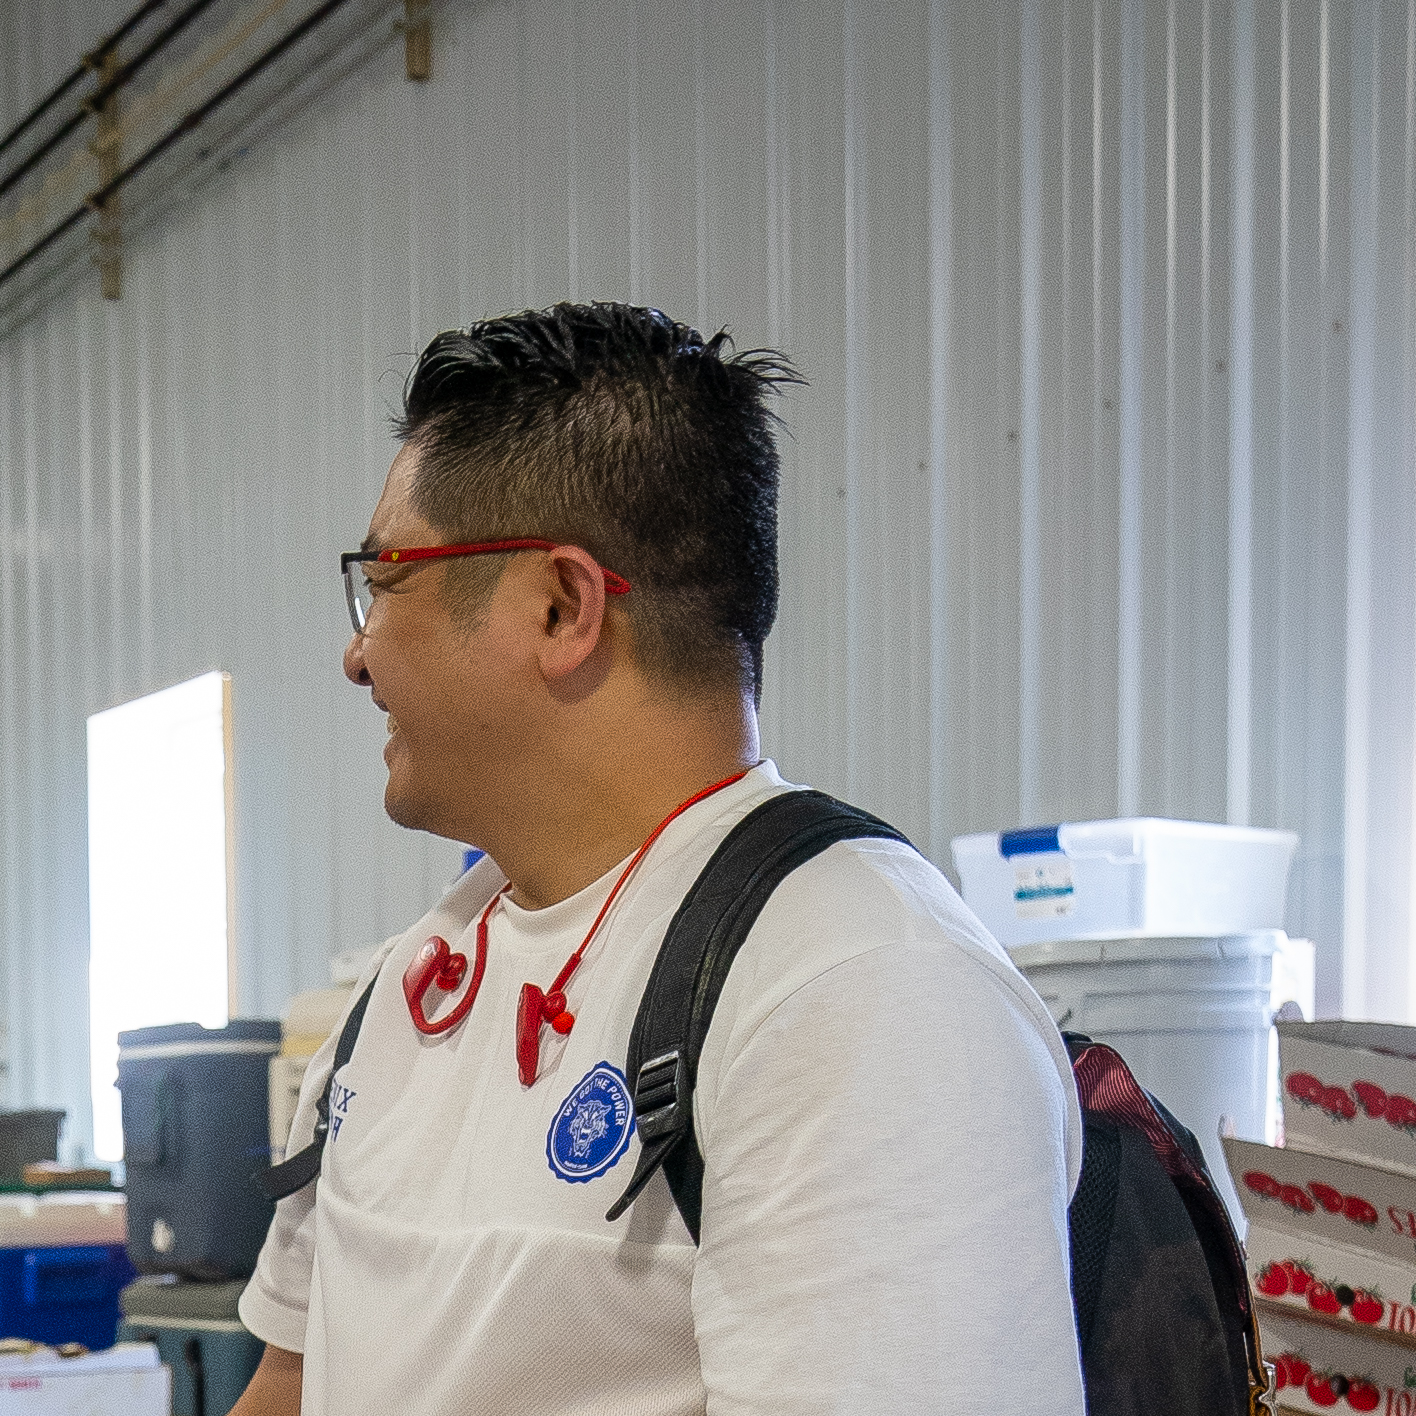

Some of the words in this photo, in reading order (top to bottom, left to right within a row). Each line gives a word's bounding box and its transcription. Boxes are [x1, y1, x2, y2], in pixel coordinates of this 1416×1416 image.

[564, 1099, 579, 1117] WE
[579, 1081, 594, 1099] GOT
[594, 1077, 611, 1091] THE
[606, 1086, 626, 1127] POWER
